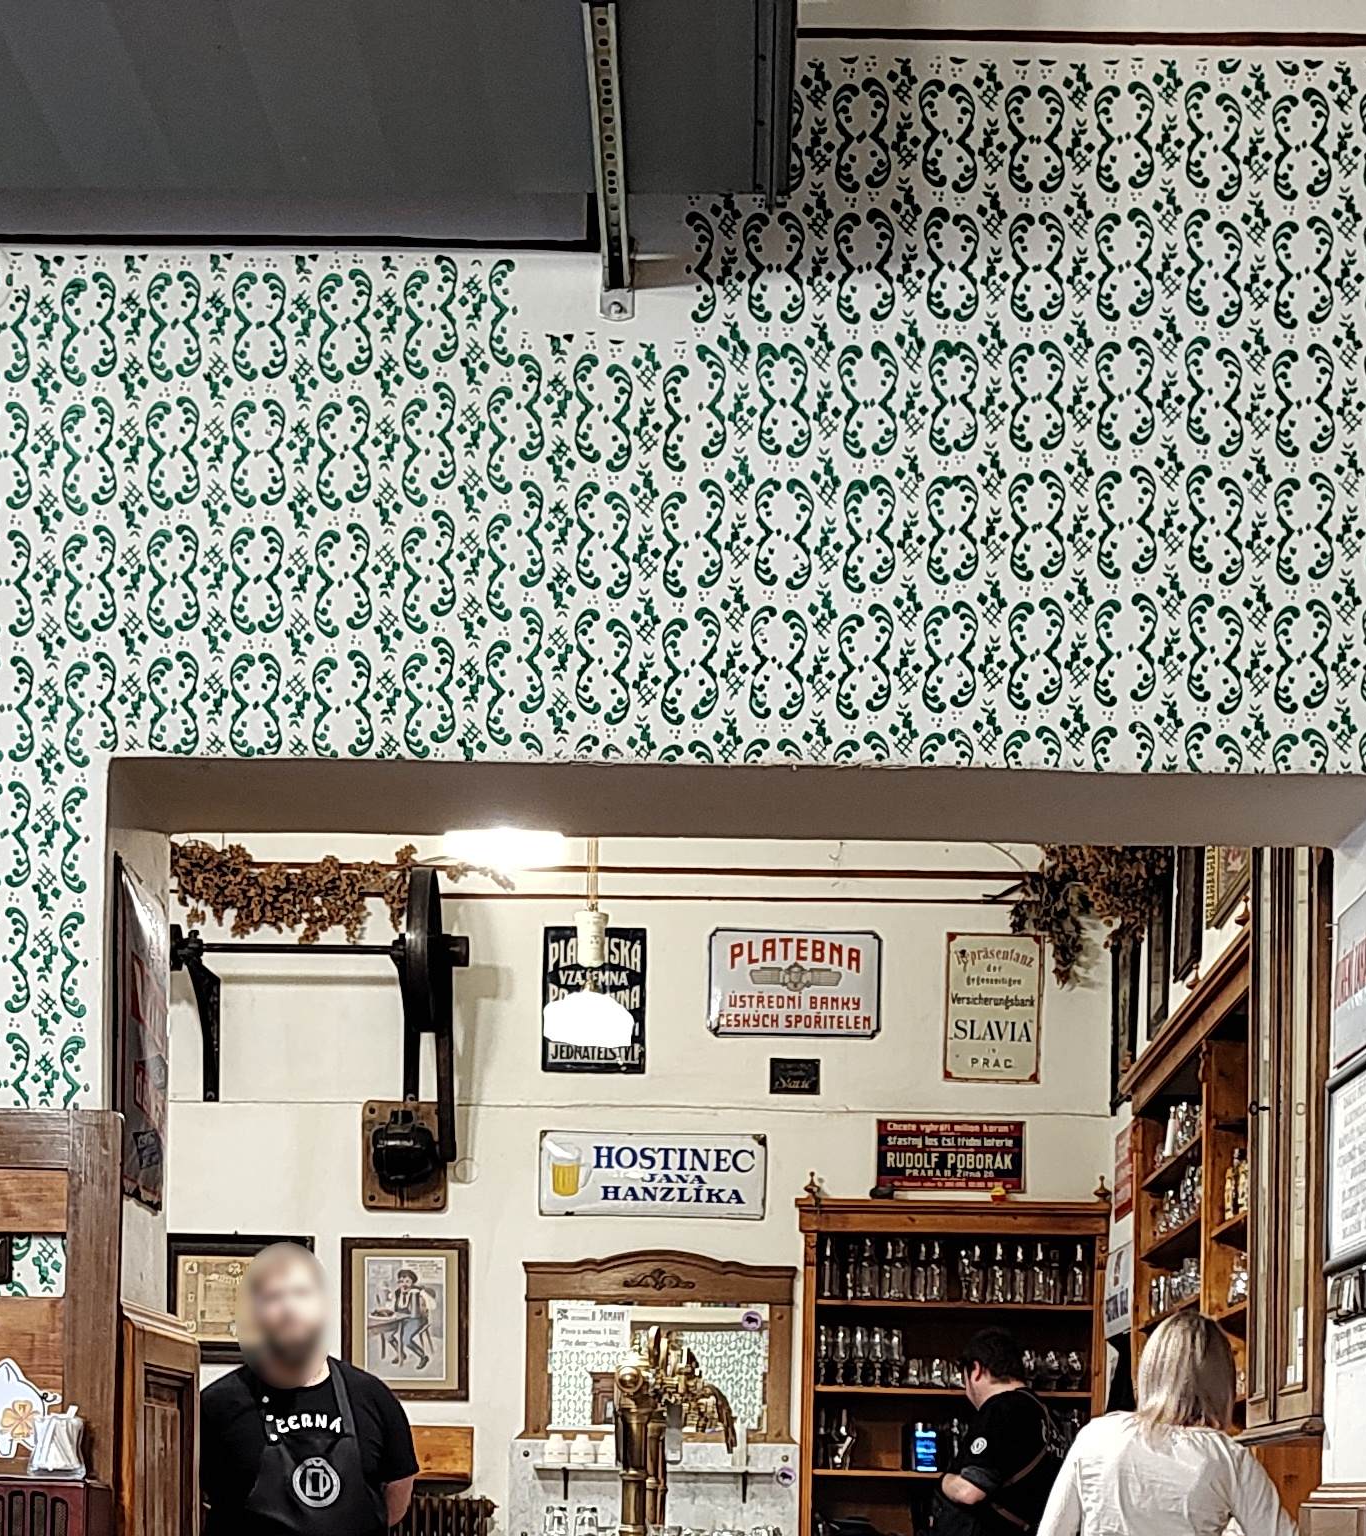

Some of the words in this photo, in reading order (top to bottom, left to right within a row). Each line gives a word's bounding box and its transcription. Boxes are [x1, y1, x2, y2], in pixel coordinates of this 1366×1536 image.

[548, 937, 641, 973] PLASKÁ
[730, 937, 861, 974] PLATEBNA
[986, 964, 1002, 972] der
[728, 990, 803, 1009] ÚSTŘEDNÍ
[809, 996, 861, 1011] BANKY
[951, 992, 1035, 1010] Versicherungsbank
[718, 1009, 779, 1028] ČESKÝCH
[784, 1011, 872, 1030] SPOŘITELEN
[887, 1122, 917, 1132] Chcete
[593, 1146, 756, 1173] HOSTINEC
[887, 1152, 939, 1168] RUDOLF
[947, 1151, 1013, 1170] POBORÁK
[641, 1173, 707, 1185] JANA
[905, 1169, 941, 1177] PRAHA
[601, 1185, 746, 1205] HANZLÍKA
